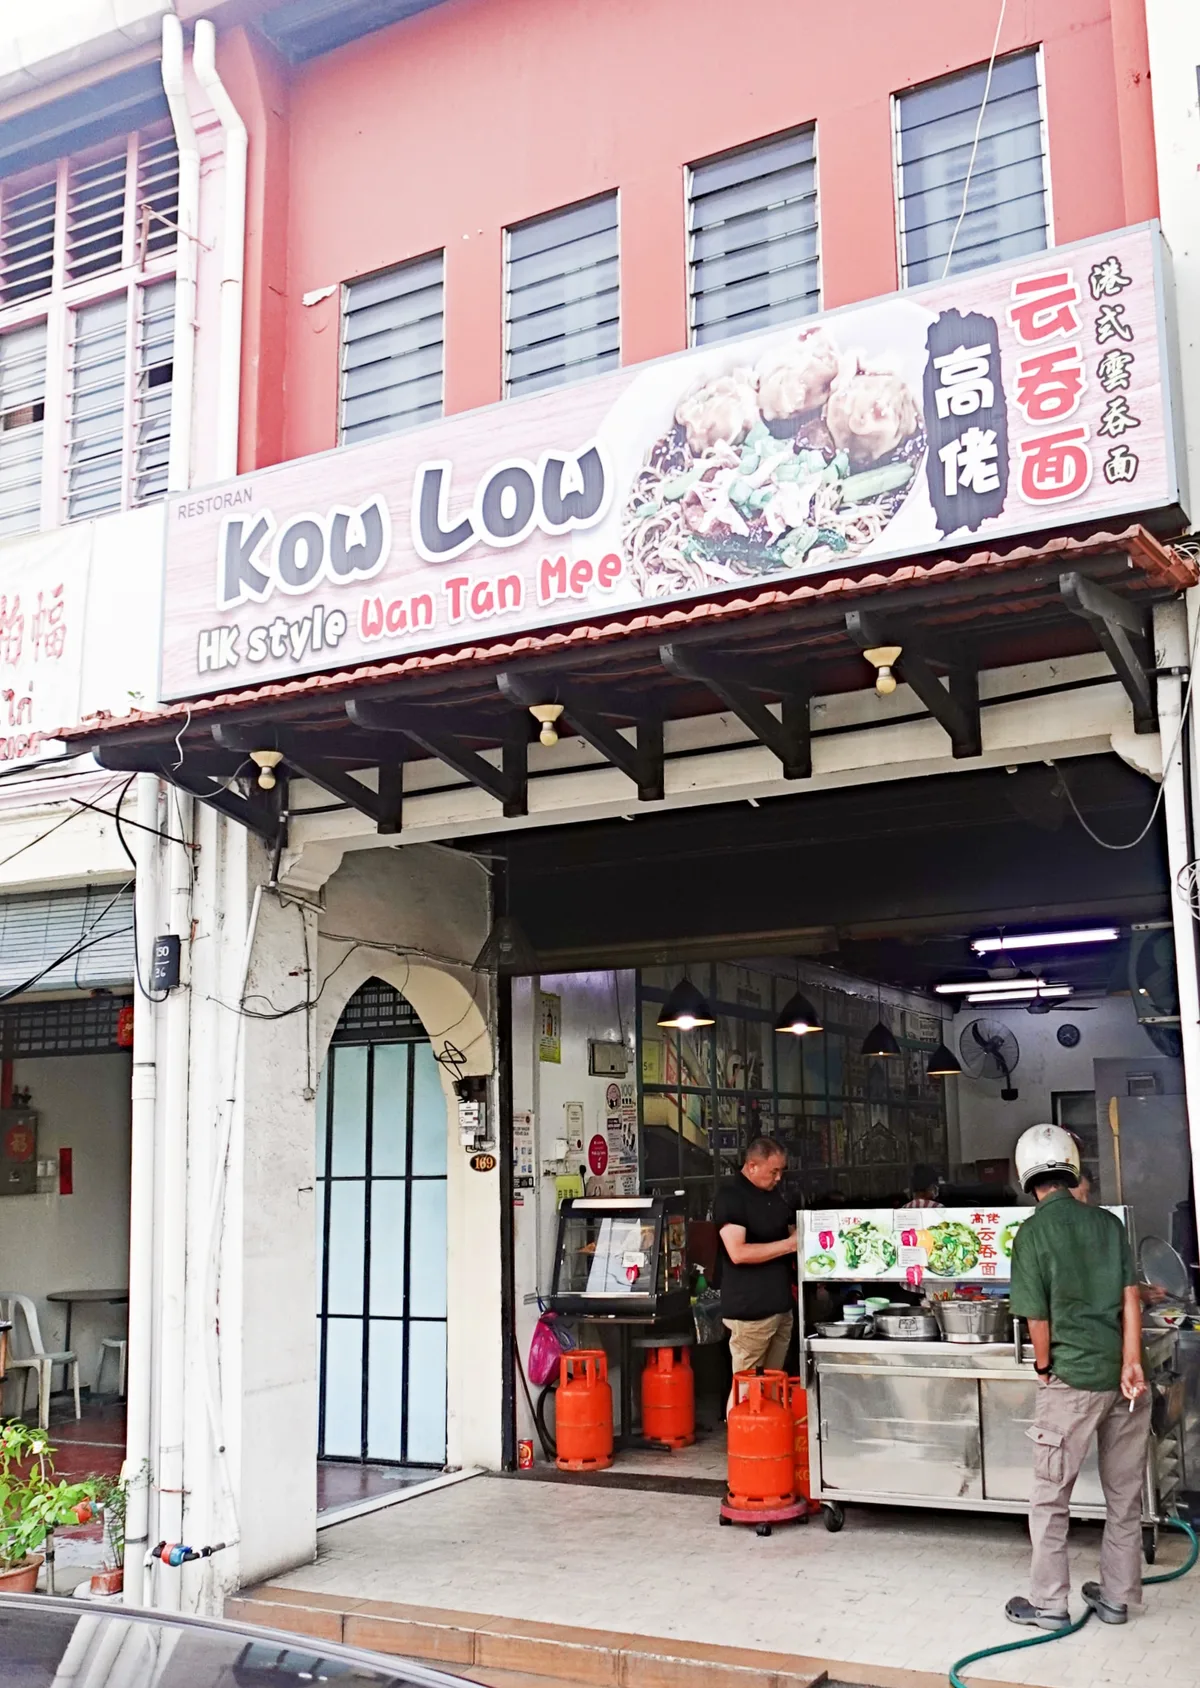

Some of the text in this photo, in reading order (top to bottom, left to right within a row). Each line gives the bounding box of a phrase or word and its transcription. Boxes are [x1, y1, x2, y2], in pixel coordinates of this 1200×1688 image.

[1009, 271, 1089, 501] 云吞面
[933, 343, 1001, 497] 高佬
[178, 488, 252, 520] RESTORAN
[361, 552, 623, 639] Wan Tan Mee
[199, 604, 347, 674] HK style
[474, 1156, 494, 1170] 169
[970, 1213, 1000, 1224] 高佬
[976, 1227, 998, 1276] 云吞面
